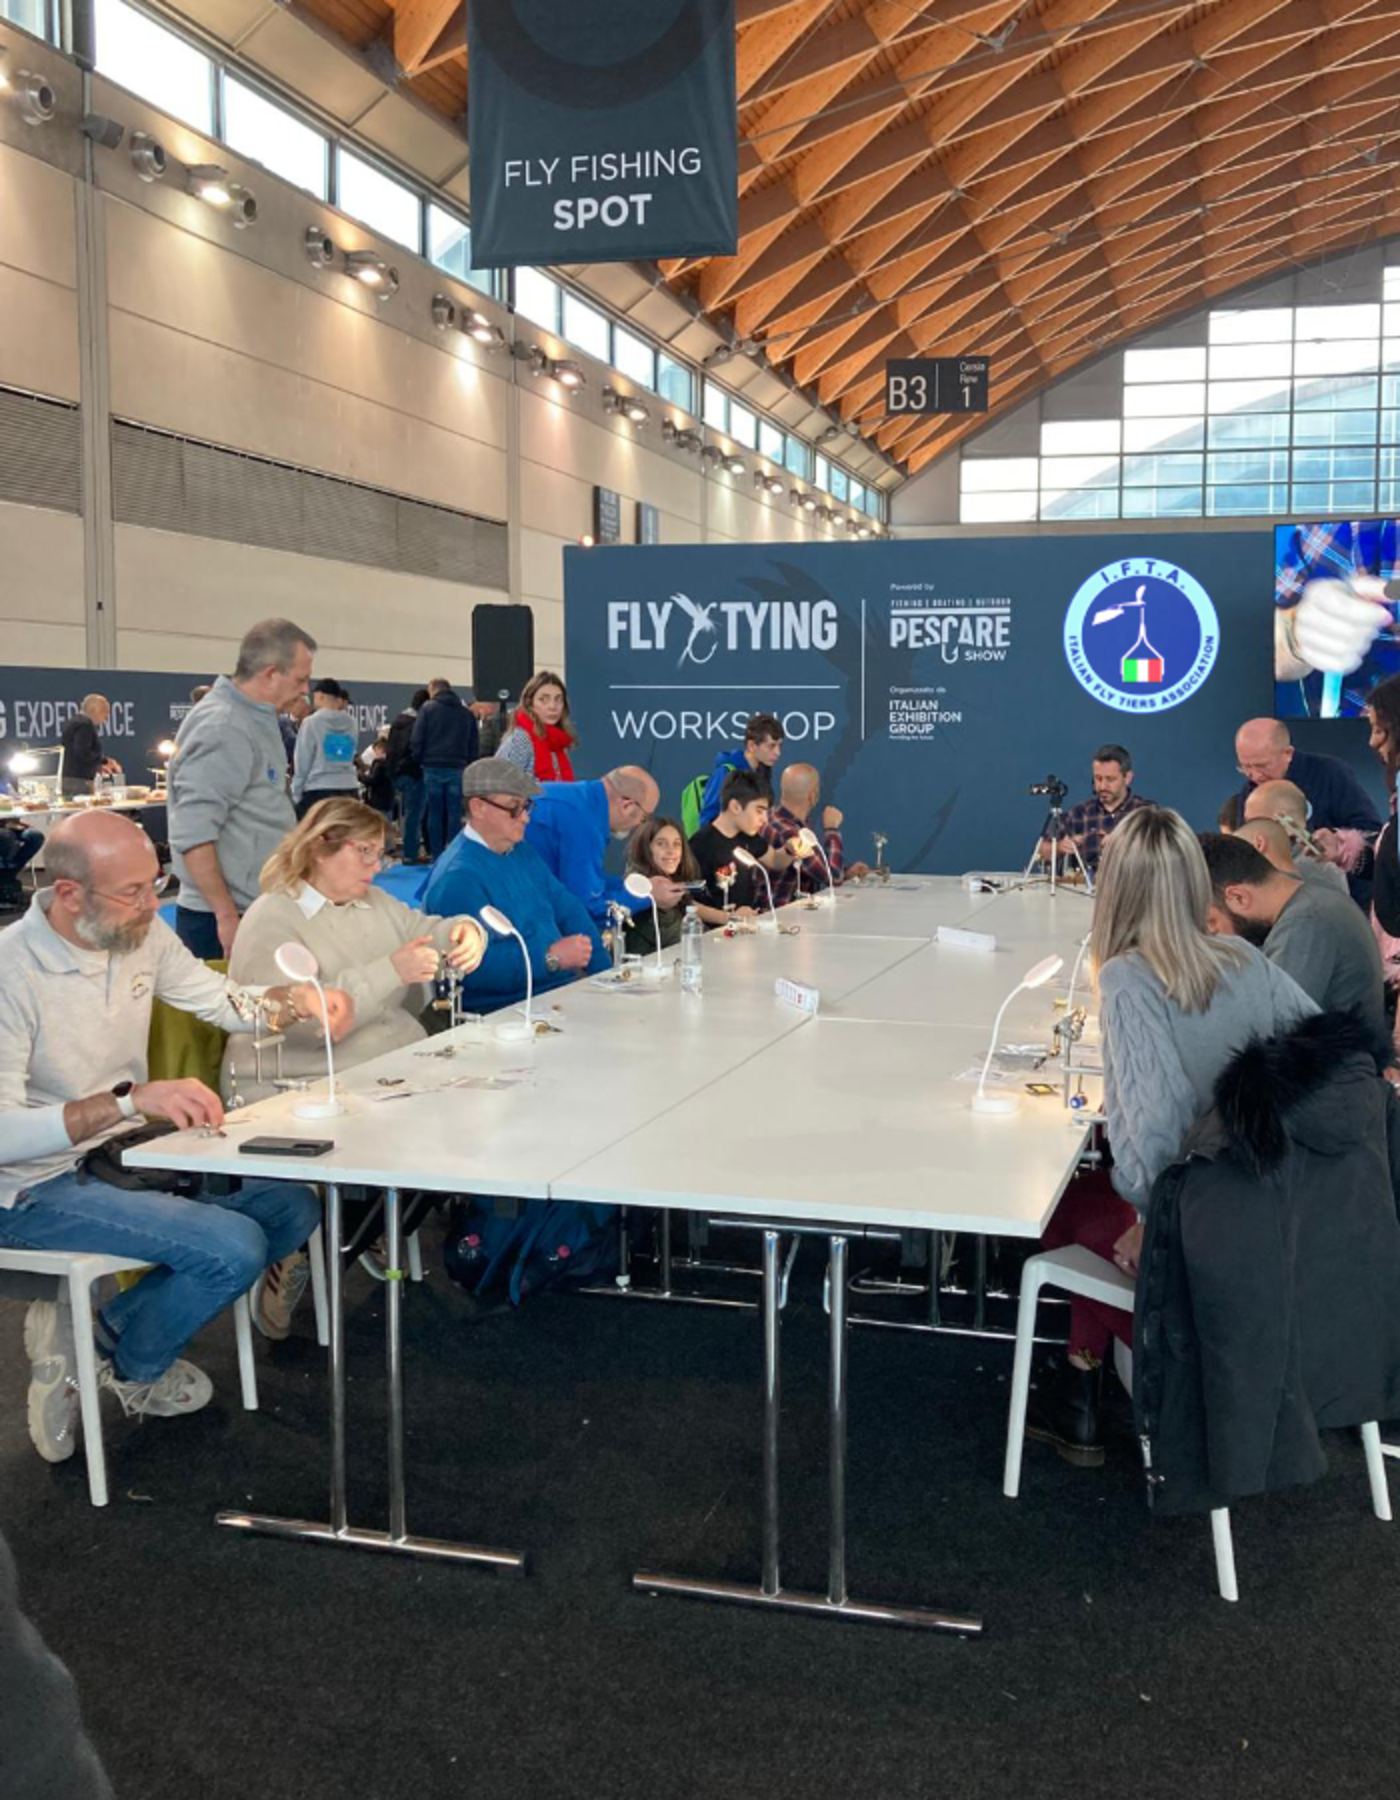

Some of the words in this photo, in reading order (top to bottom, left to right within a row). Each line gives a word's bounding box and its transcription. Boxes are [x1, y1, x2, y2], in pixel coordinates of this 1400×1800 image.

[505, 157, 560, 188] FLY
[571, 147, 702, 183] FISHING
[553, 194, 653, 230] SPOT
[889, 375, 927, 411] B3
[961, 386, 970, 408] 1
[1100, 561, 1186, 590] I.F.T.A.
[607, 601, 673, 650] FLY
[719, 600, 838, 651] TYING
[890, 615, 1011, 663] PESCARE
[964, 650, 1007, 661] SHOW
[1068, 635, 1094, 685] ITALIAN
[1093, 683, 1115, 702] FLY
[1119, 696, 1157, 709] TIERS
[1161, 635, 1215, 706] ASSOCIATION
[889, 700, 938, 711] ITALIAN
[889, 711, 962, 723] EXHIBITION
[611, 710, 836, 741] WORKSOP
[889, 723, 935, 735] GROUP
